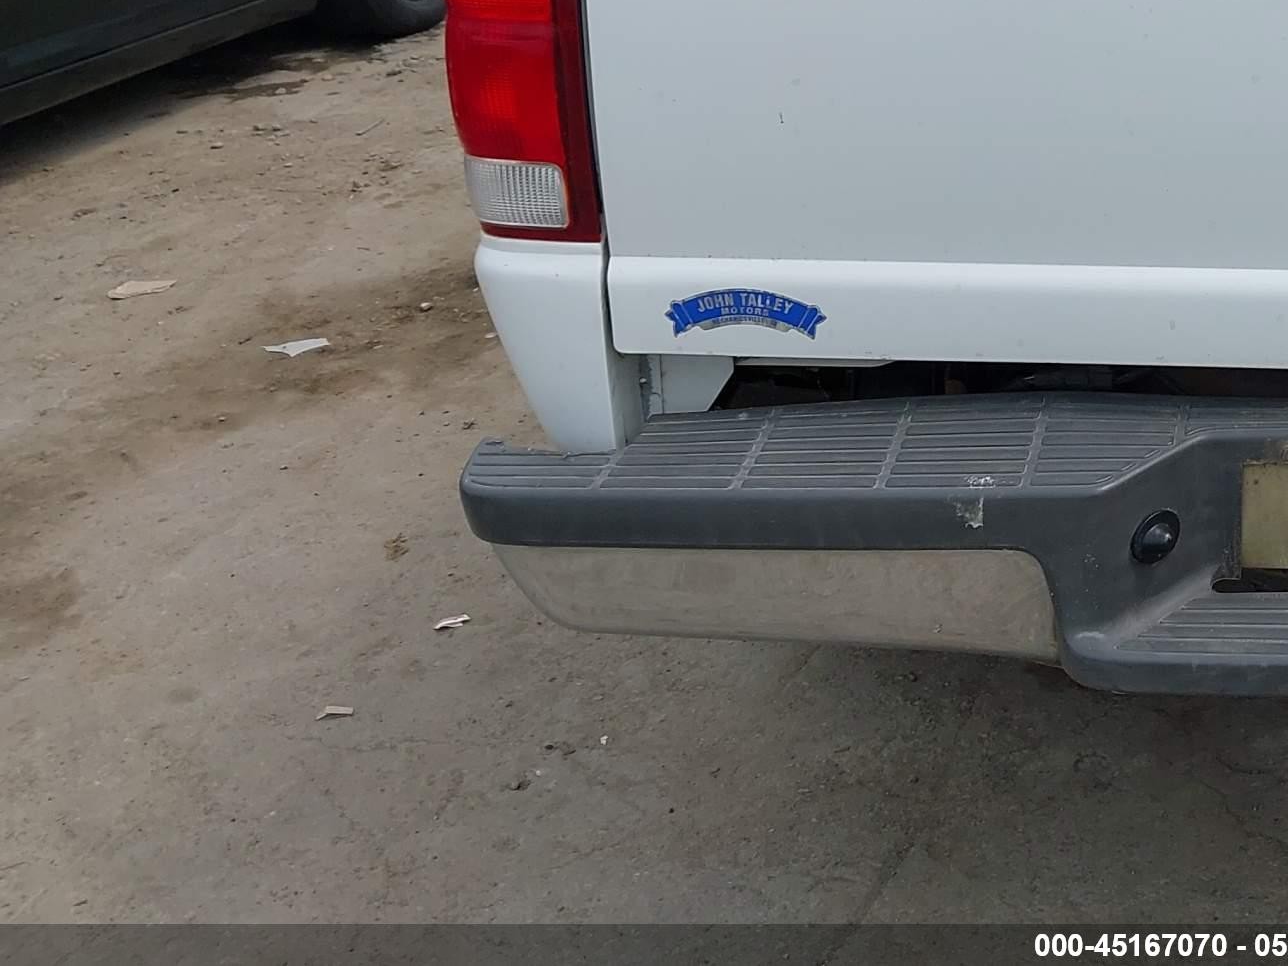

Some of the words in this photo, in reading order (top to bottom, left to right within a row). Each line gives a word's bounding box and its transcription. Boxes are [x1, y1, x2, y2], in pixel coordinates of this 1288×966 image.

[696, 293, 734, 313] JOHN
[739, 292, 794, 314] TALLEY
[720, 307, 769, 317] MOTORS
